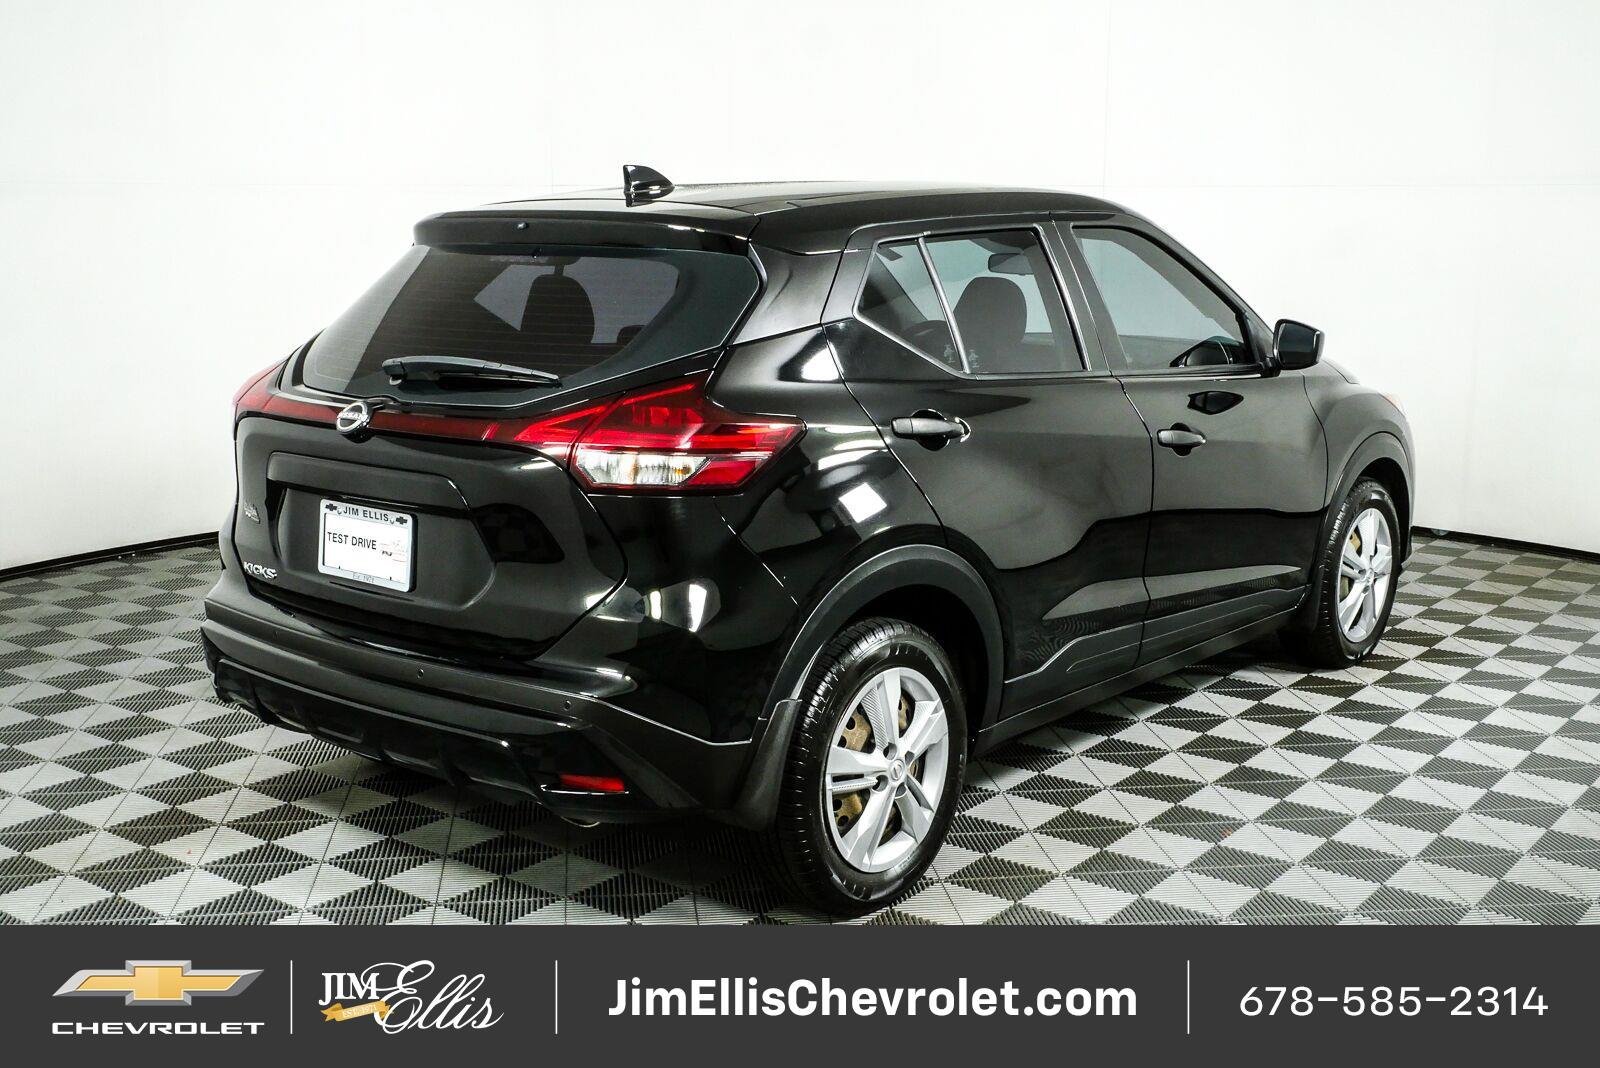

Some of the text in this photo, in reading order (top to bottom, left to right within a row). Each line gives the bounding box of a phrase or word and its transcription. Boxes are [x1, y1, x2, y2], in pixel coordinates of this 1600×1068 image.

[343, 506, 389, 522] JIM ELLIS
[327, 531, 377, 550] TEST DRIVE
[243, 561, 278, 579] KICKS
